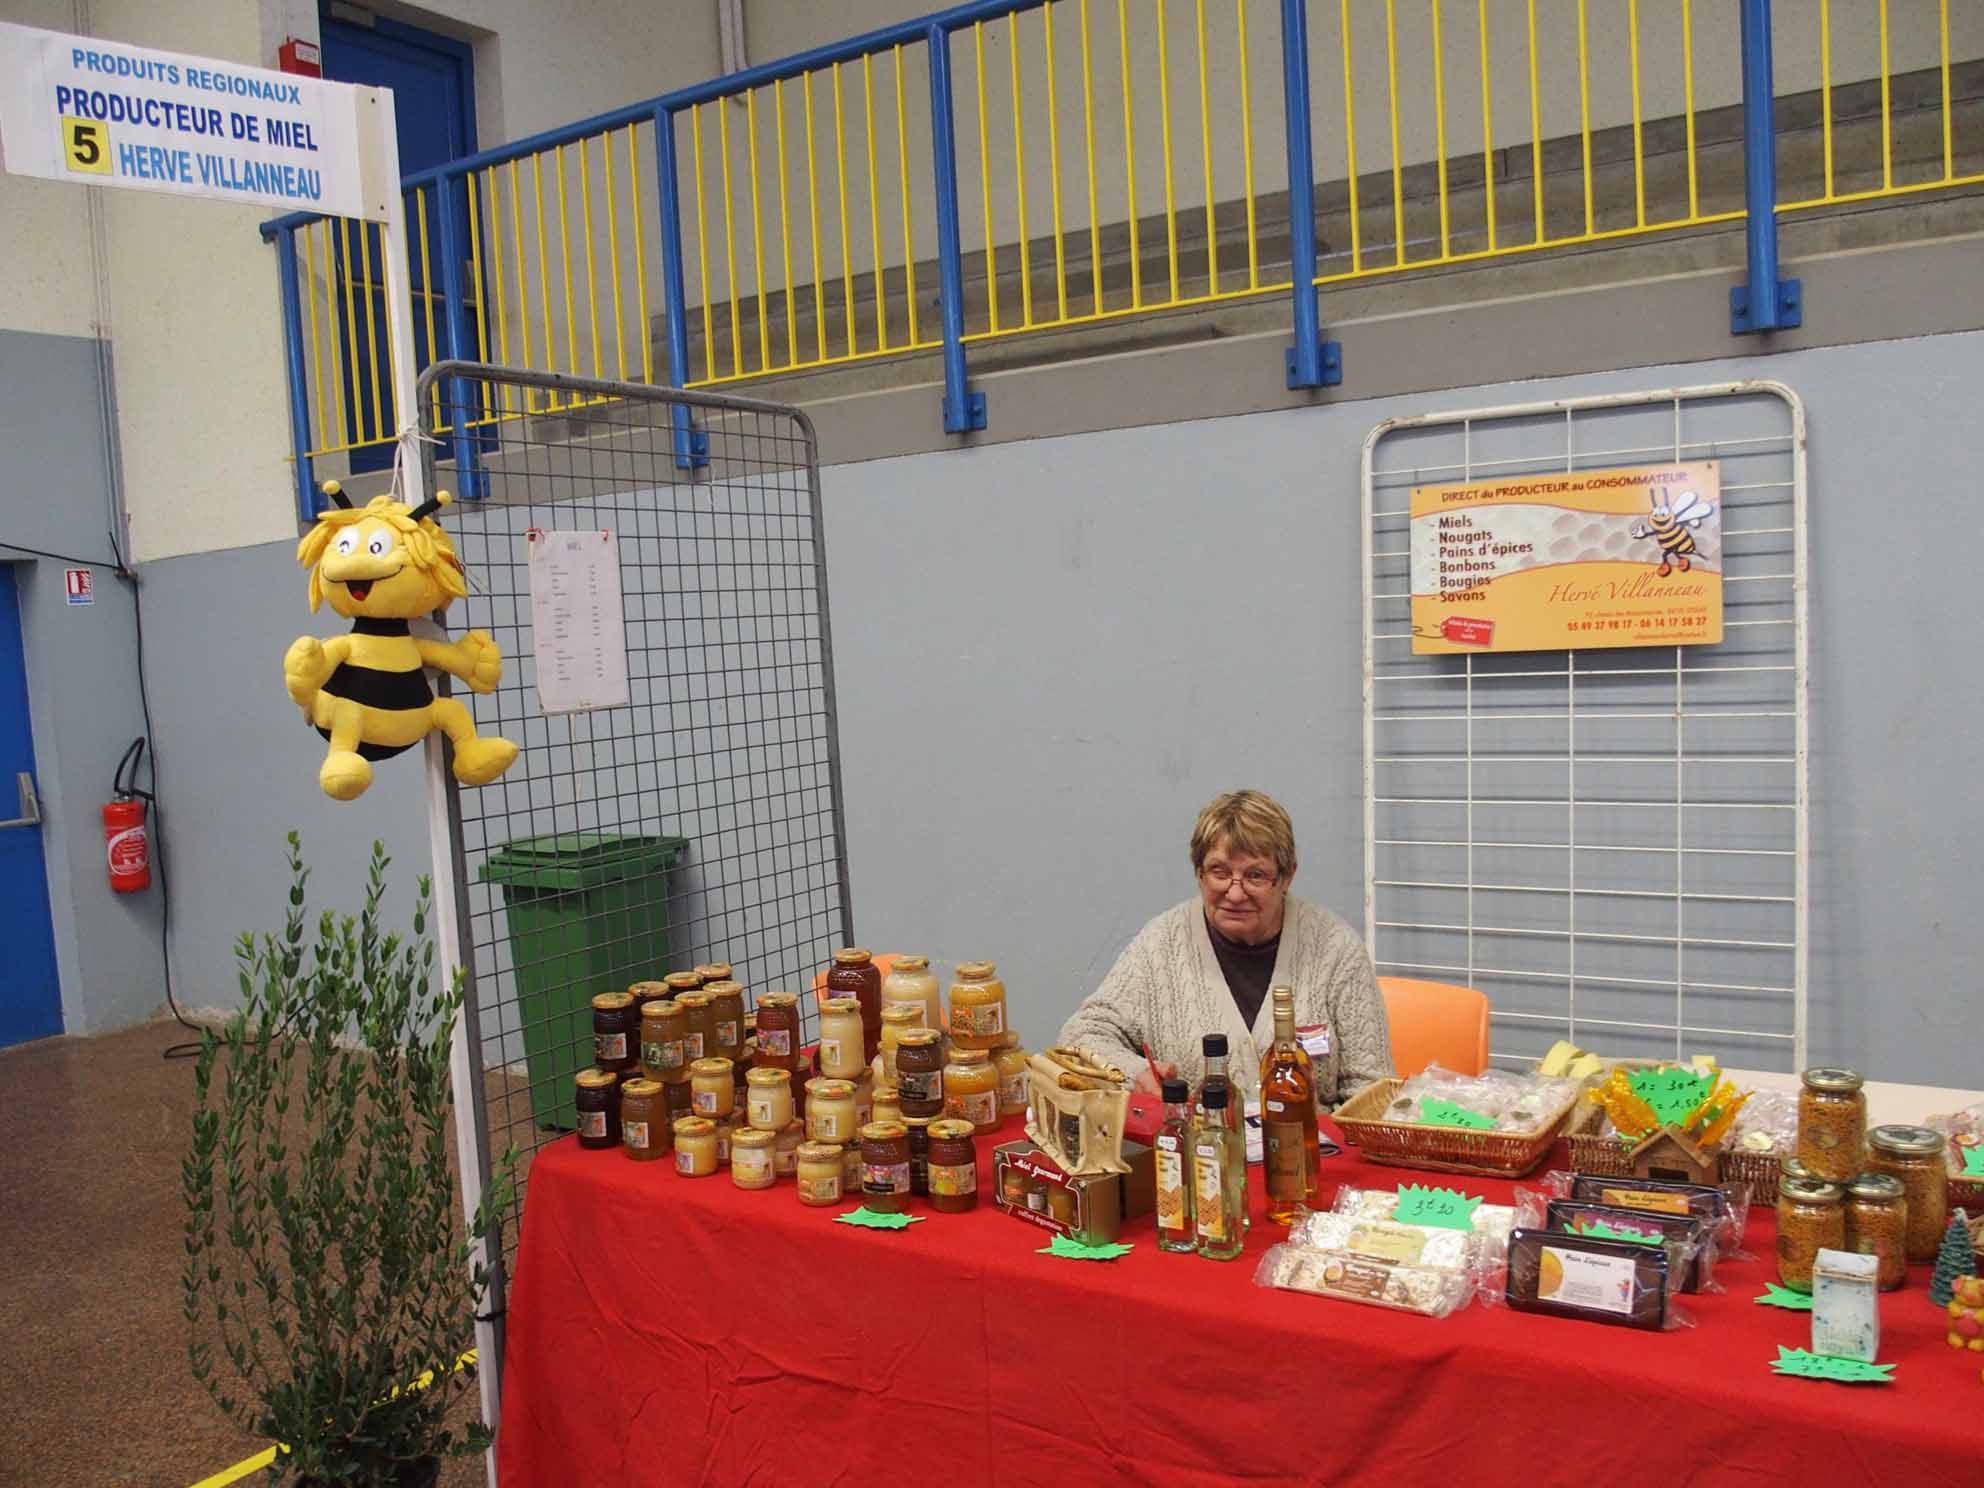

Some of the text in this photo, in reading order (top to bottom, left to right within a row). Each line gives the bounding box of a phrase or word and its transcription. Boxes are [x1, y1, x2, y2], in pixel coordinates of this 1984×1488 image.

[72, 48, 301, 105] PRODUITS REGIONAUX
[56, 85, 318, 151] PRODUCTEUR DE MIEL
[73, 125, 100, 164] 5
[119, 143, 321, 200] HERVE VILLANNEAU
[1441, 472, 1689, 502] DIRECT du PRODUCTEUR au CONSOMMATEUR
[1439, 514, 1472, 529] Miels
[1439, 531, 1493, 545] Nougats
[1440, 541, 1533, 558] Pains d'épices
[1440, 559, 1496, 573] Bonbons
[1440, 575, 1491, 589] Bougies
[1550, 572, 1704, 603] Hervé Villanneau
[1440, 591, 1486, 603] Savons
